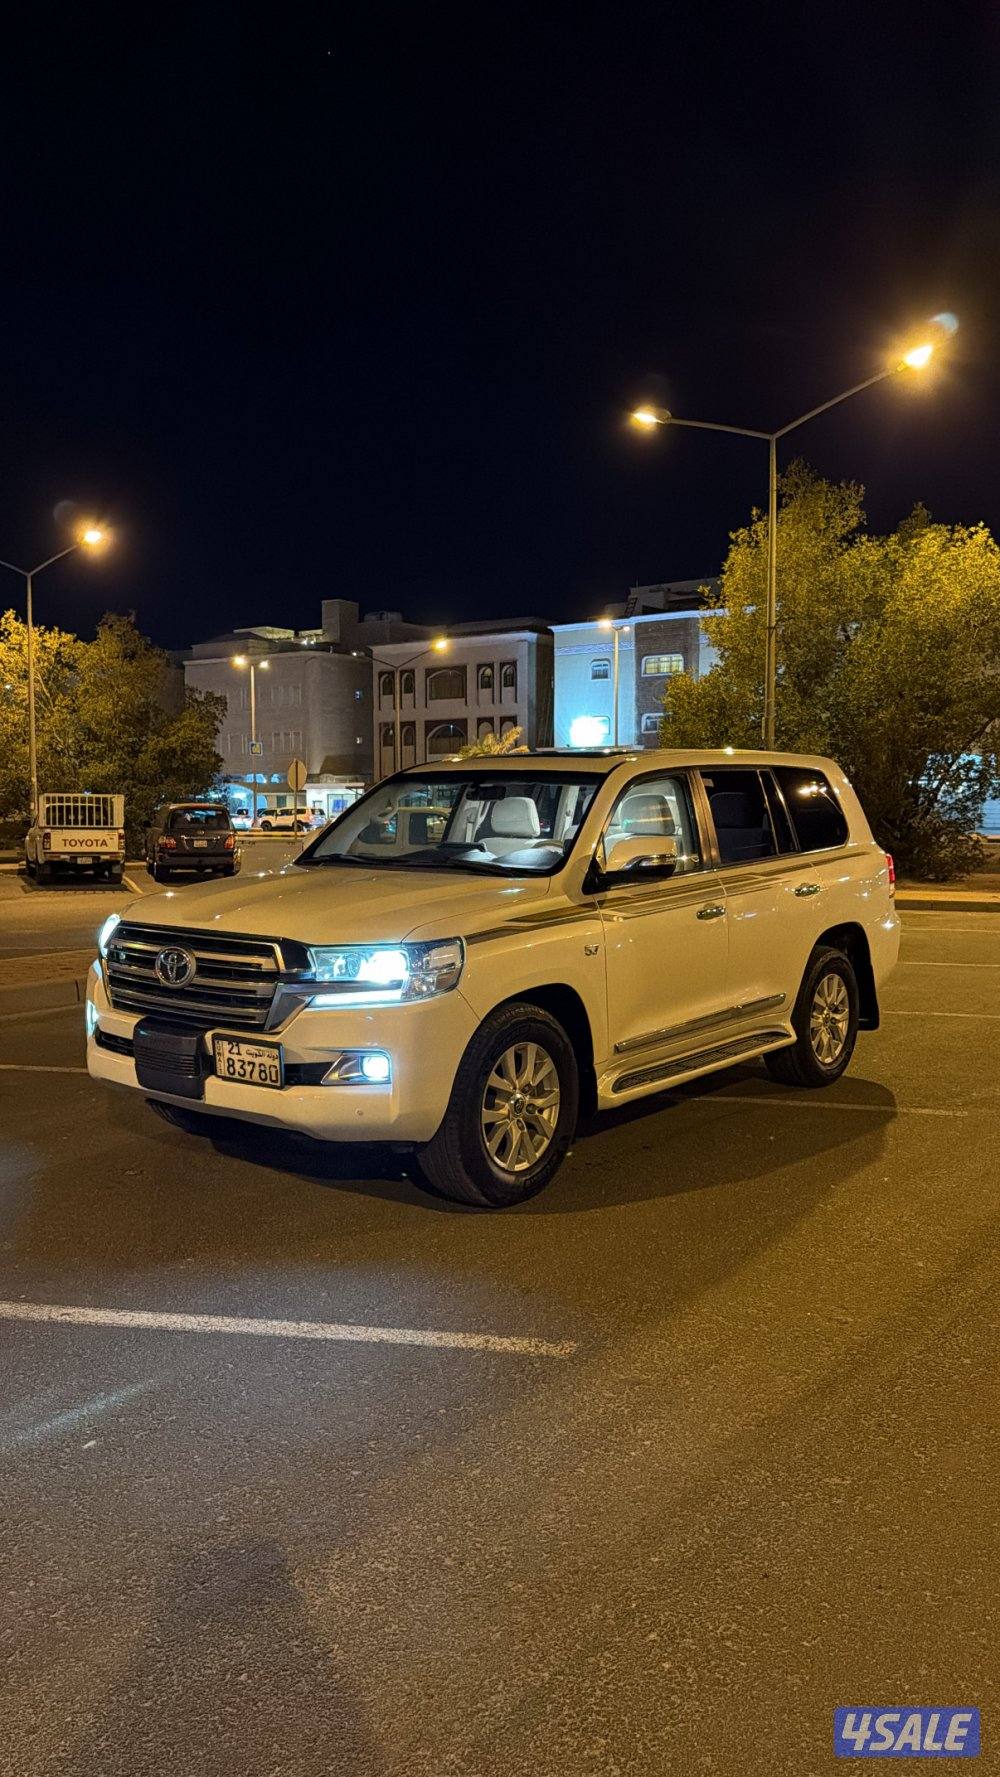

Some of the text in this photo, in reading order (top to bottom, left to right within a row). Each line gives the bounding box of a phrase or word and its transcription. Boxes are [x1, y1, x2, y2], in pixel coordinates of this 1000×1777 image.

[62, 838, 108, 848] TOYOTA
[228, 1041, 242, 1056] 21
[227, 1058, 278, 1083] 83780
